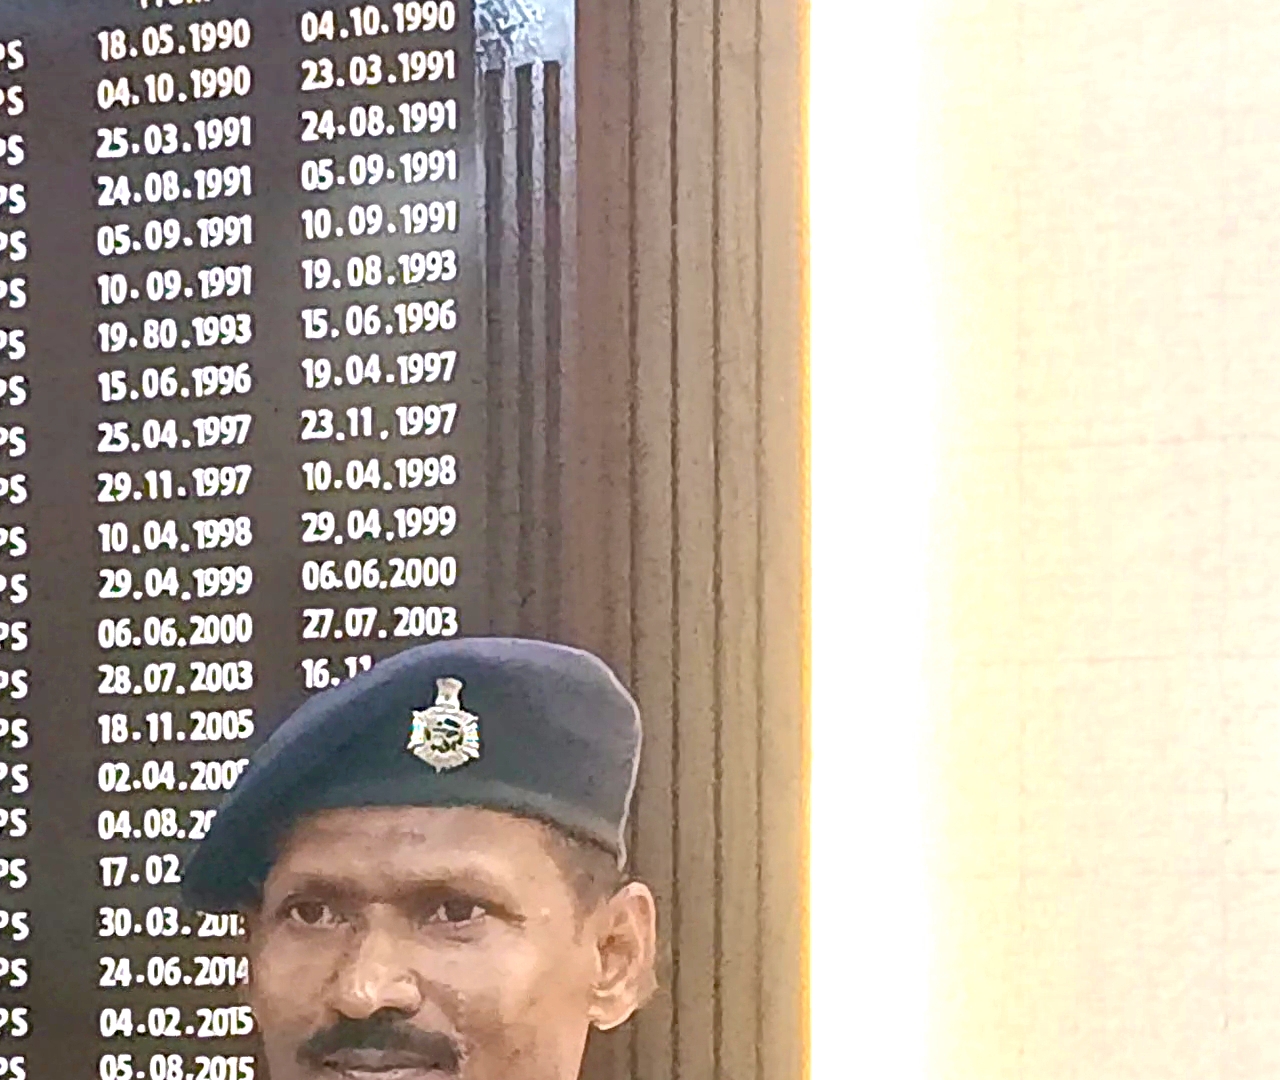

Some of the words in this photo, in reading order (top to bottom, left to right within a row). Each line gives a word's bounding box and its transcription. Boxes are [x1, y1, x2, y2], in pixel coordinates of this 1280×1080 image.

[98, 18, 250, 61] 18.05.1990
[302, 1, 455, 42] 04.10.1990
[97, 65, 250, 109] 04.10.1990
[301, 50, 454, 90] 23.03.1991
[97, 116, 250, 158] 25.03.1991
[302, 100, 455, 141] 24.08.1991
[98, 165, 251, 205] 24.08.1991
[302, 150, 455, 190] 05.09.1991
[98, 215, 251, 255] 05.09.1991
[302, 201, 455, 239] 10.09.1991
[98, 265, 251, 305] 10.09.1991
[302, 250, 456, 289] 19.08.1993
[98, 314, 251, 352] 19.80.1993
[302, 299, 456, 338] 15.06.1996
[98, 363, 251, 401] 15.06.1996
[302, 351, 456, 388] 19.04.1997
[98, 414, 251, 452] 25.04.1997
[98, 465, 251, 502] 29.11.1997
[302, 455, 456, 490] 10.04.1998
[98, 517, 252, 553] 10.04.1998
[302, 506, 456, 544] 29.04.1999
[99, 566, 252, 600] 29.04.1999
[302, 557, 456, 590] 06.06.2000
[98, 613, 252, 648] 06.06.2000
[303, 607, 457, 638] 27.07.2003
[98, 661, 253, 694] 28.07.2003
[98, 709, 254, 744] 18.11.2005
[98, 759, 249, 792] 02.04.200
[100, 1006, 253, 1037] 04.02.2015
